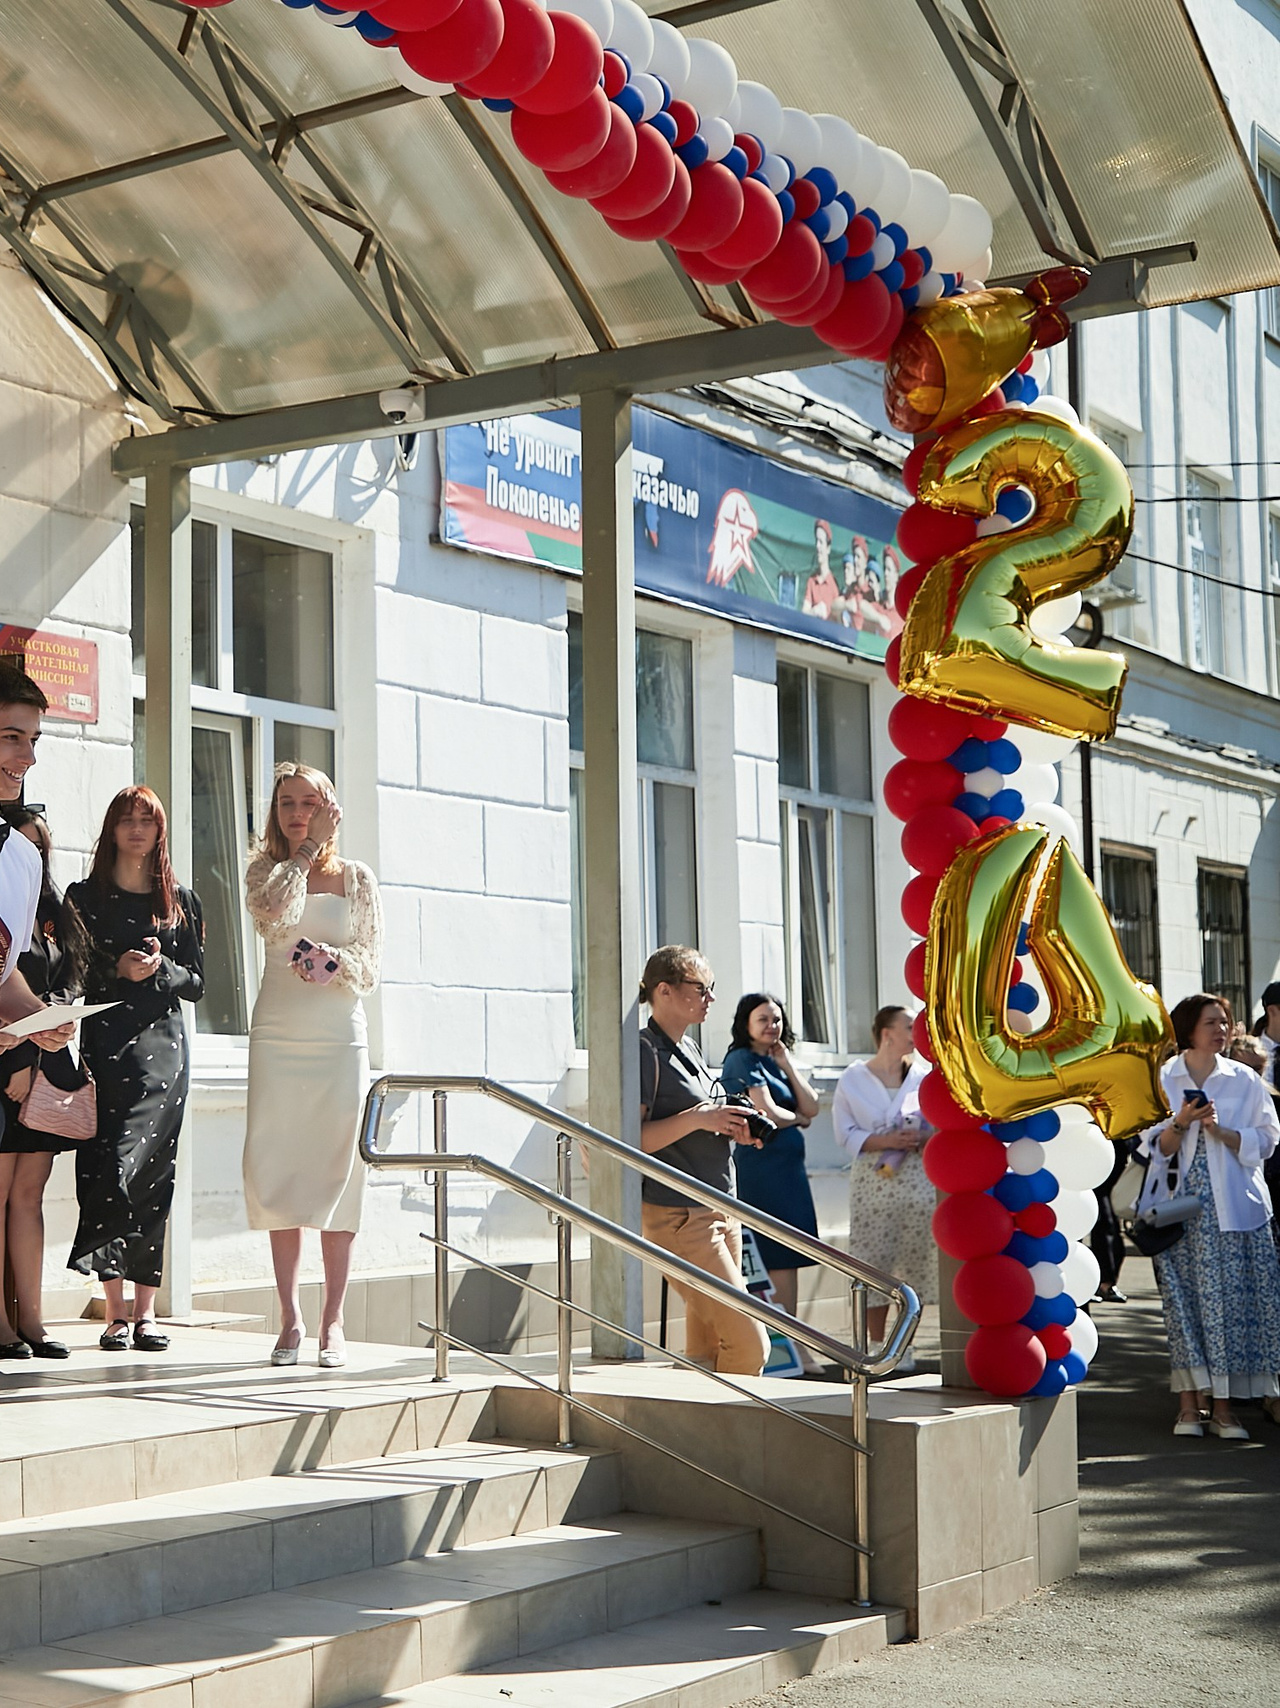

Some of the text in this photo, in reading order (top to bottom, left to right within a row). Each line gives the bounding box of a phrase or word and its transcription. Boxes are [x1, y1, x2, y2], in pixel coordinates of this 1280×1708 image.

[515, 431, 575, 478] уронит
[632, 471, 700, 519] казачью
[486, 464, 580, 532] Поколенье
[10, 636, 80, 659] УЧАСТКОВАЯ
[24, 667, 75, 687] ОМИССИЯ
